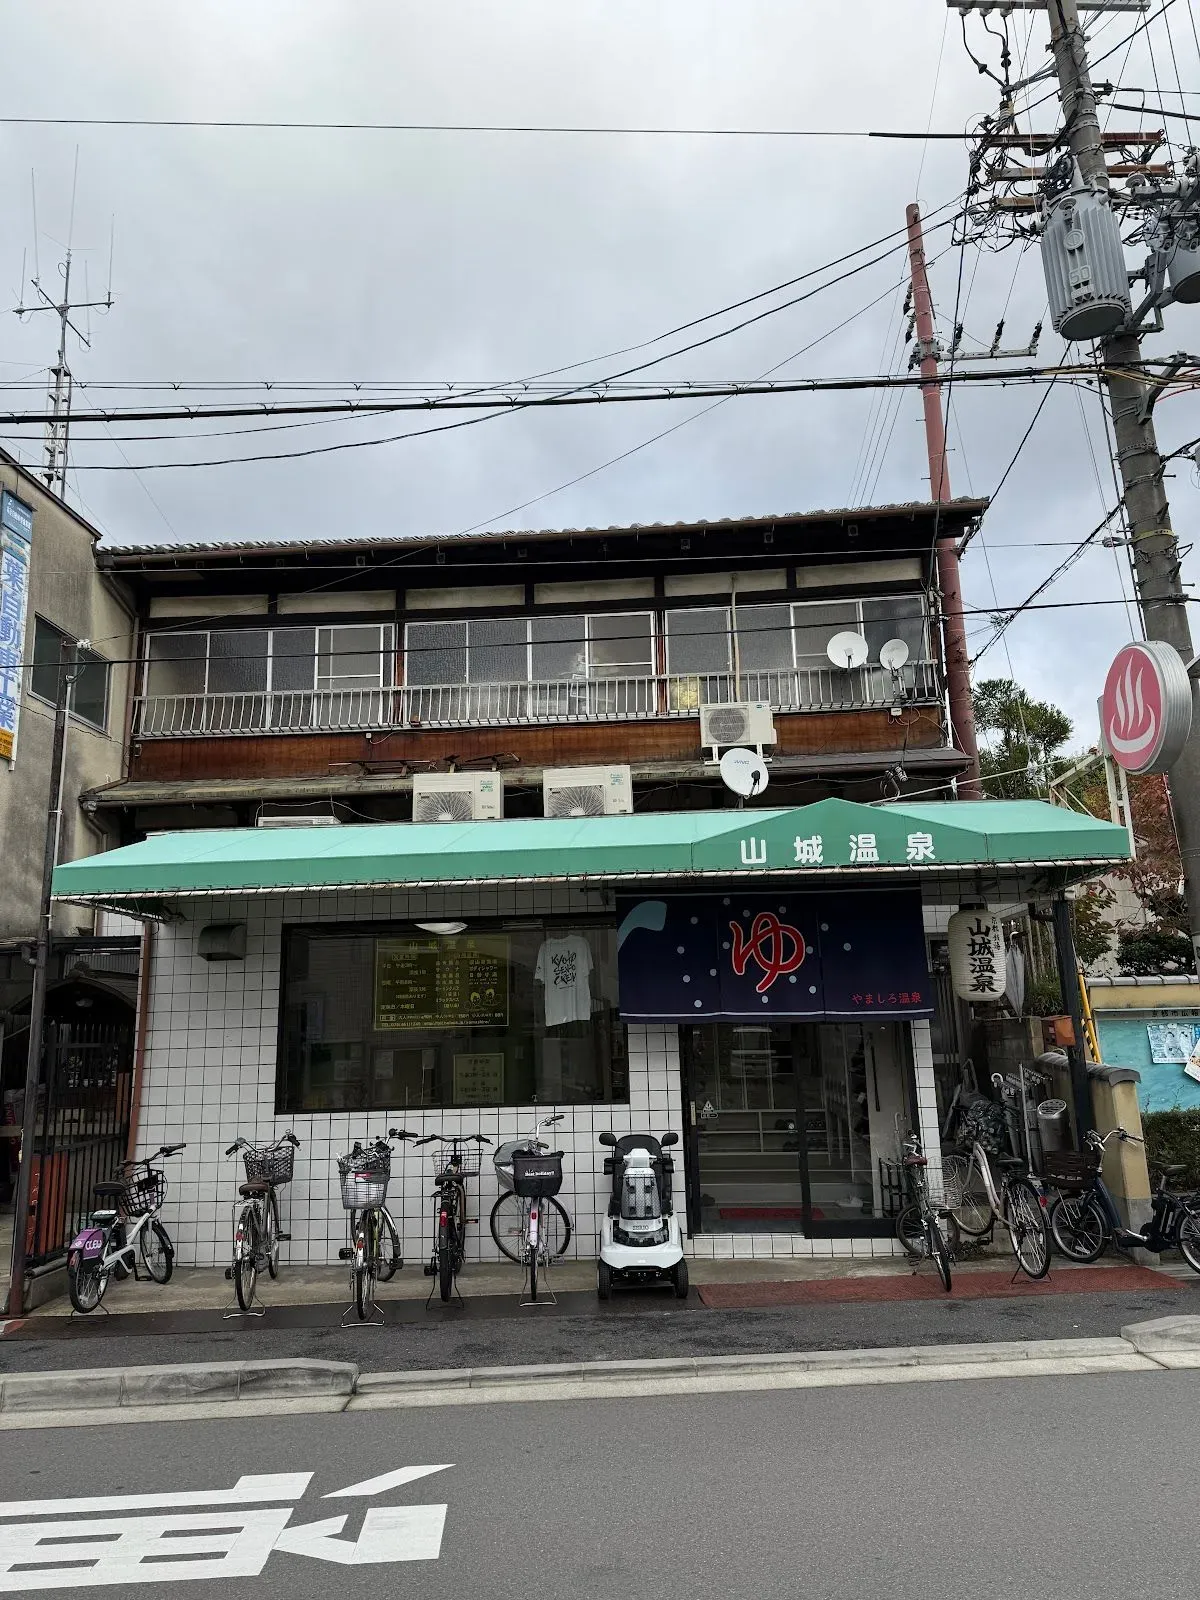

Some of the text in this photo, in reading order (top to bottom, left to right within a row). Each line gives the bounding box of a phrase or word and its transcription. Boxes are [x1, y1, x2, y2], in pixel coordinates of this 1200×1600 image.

[740, 832, 936, 864] 山城温泉
[729, 911, 806, 993] ゆ
[966, 917, 999, 993] 山城温泉
[851, 991, 922, 1005] やましろ温泉
